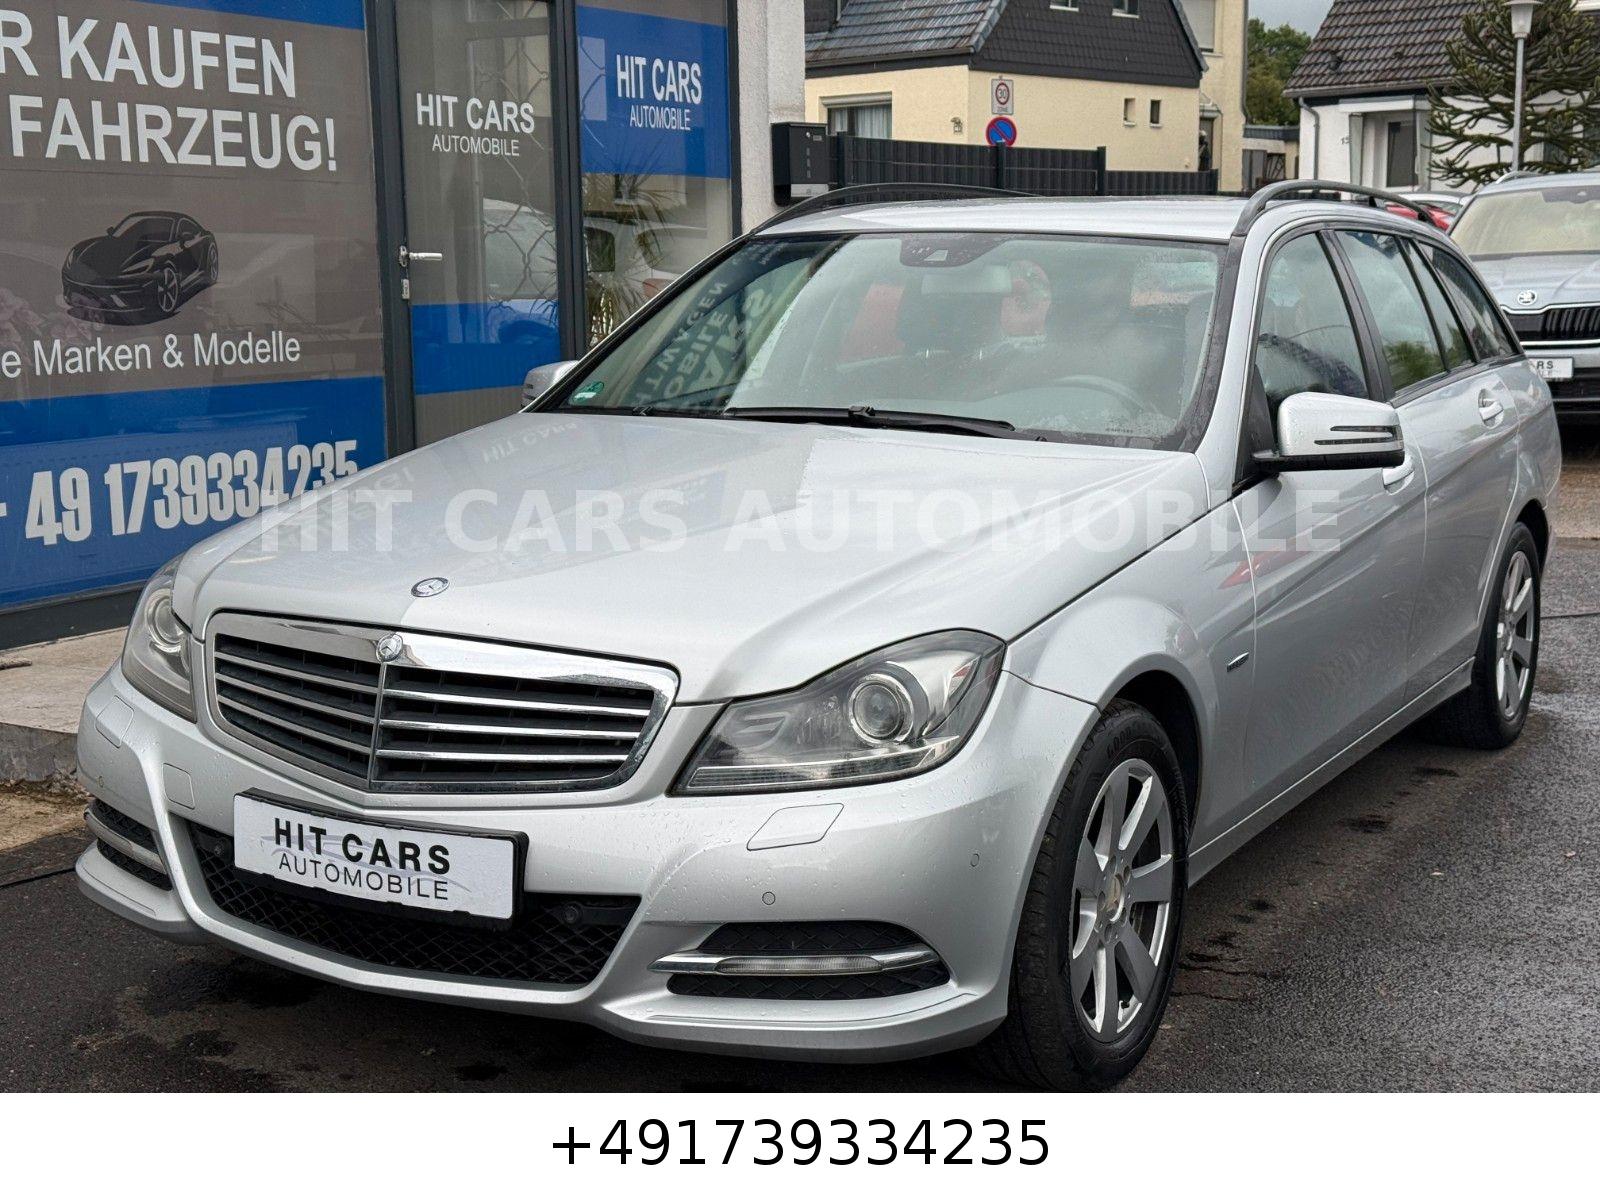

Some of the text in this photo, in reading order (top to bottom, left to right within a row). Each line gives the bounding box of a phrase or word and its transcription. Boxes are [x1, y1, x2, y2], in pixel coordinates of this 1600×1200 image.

[57, 15, 297, 99] KAUFEN
[615, 54, 702, 105] HIT CARS
[9, 94, 337, 172] FAHRZEUG!
[416, 92, 536, 134] HIT CARS
[629, 104, 691, 131] AUTOMOBILE
[432, 133, 520, 157] AUTOMOBILE
[1, 330, 301, 378] e Marken & Modelle
[25, 467, 92, 546] 49
[274, 817, 451, 875] HIT CARS
[278, 853, 449, 901] AUTOMOBILE
